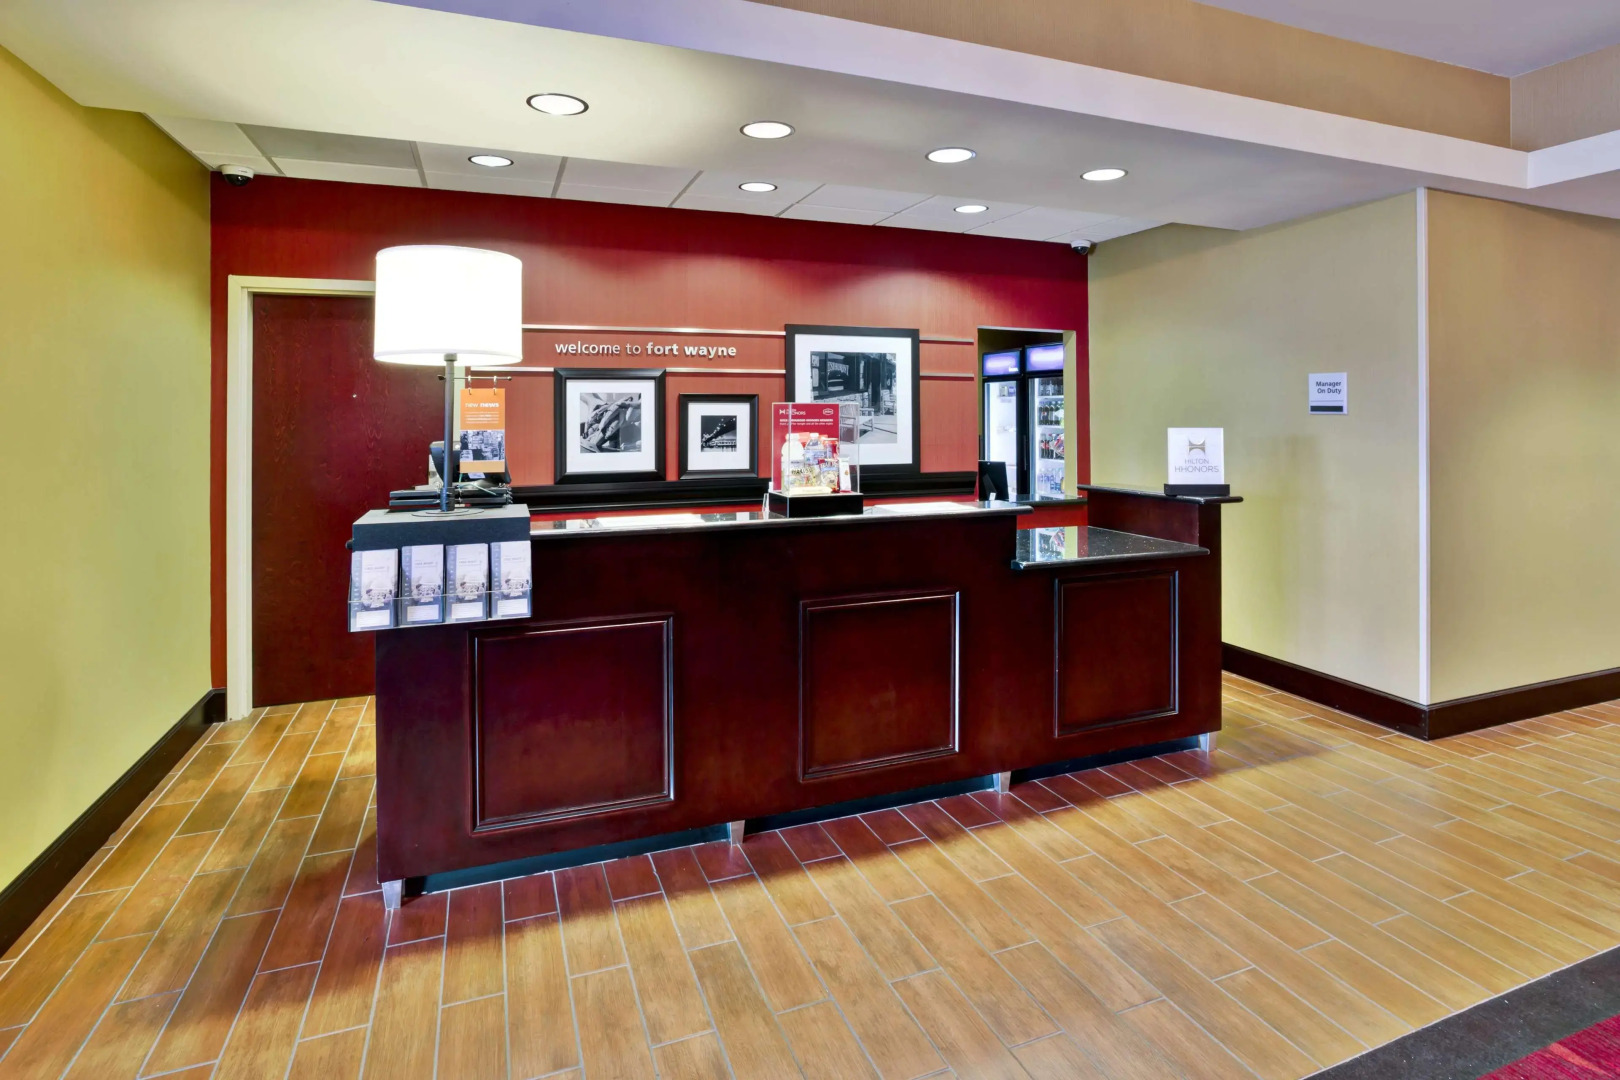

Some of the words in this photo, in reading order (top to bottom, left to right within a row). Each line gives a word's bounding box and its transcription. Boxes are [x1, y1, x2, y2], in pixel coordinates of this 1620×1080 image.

[555, 341, 621, 354] welcome
[626, 343, 641, 354] to
[646, 342, 678, 355] fort
[684, 344, 737, 359] wayne
[1174, 465, 1220, 473] HHONORS
